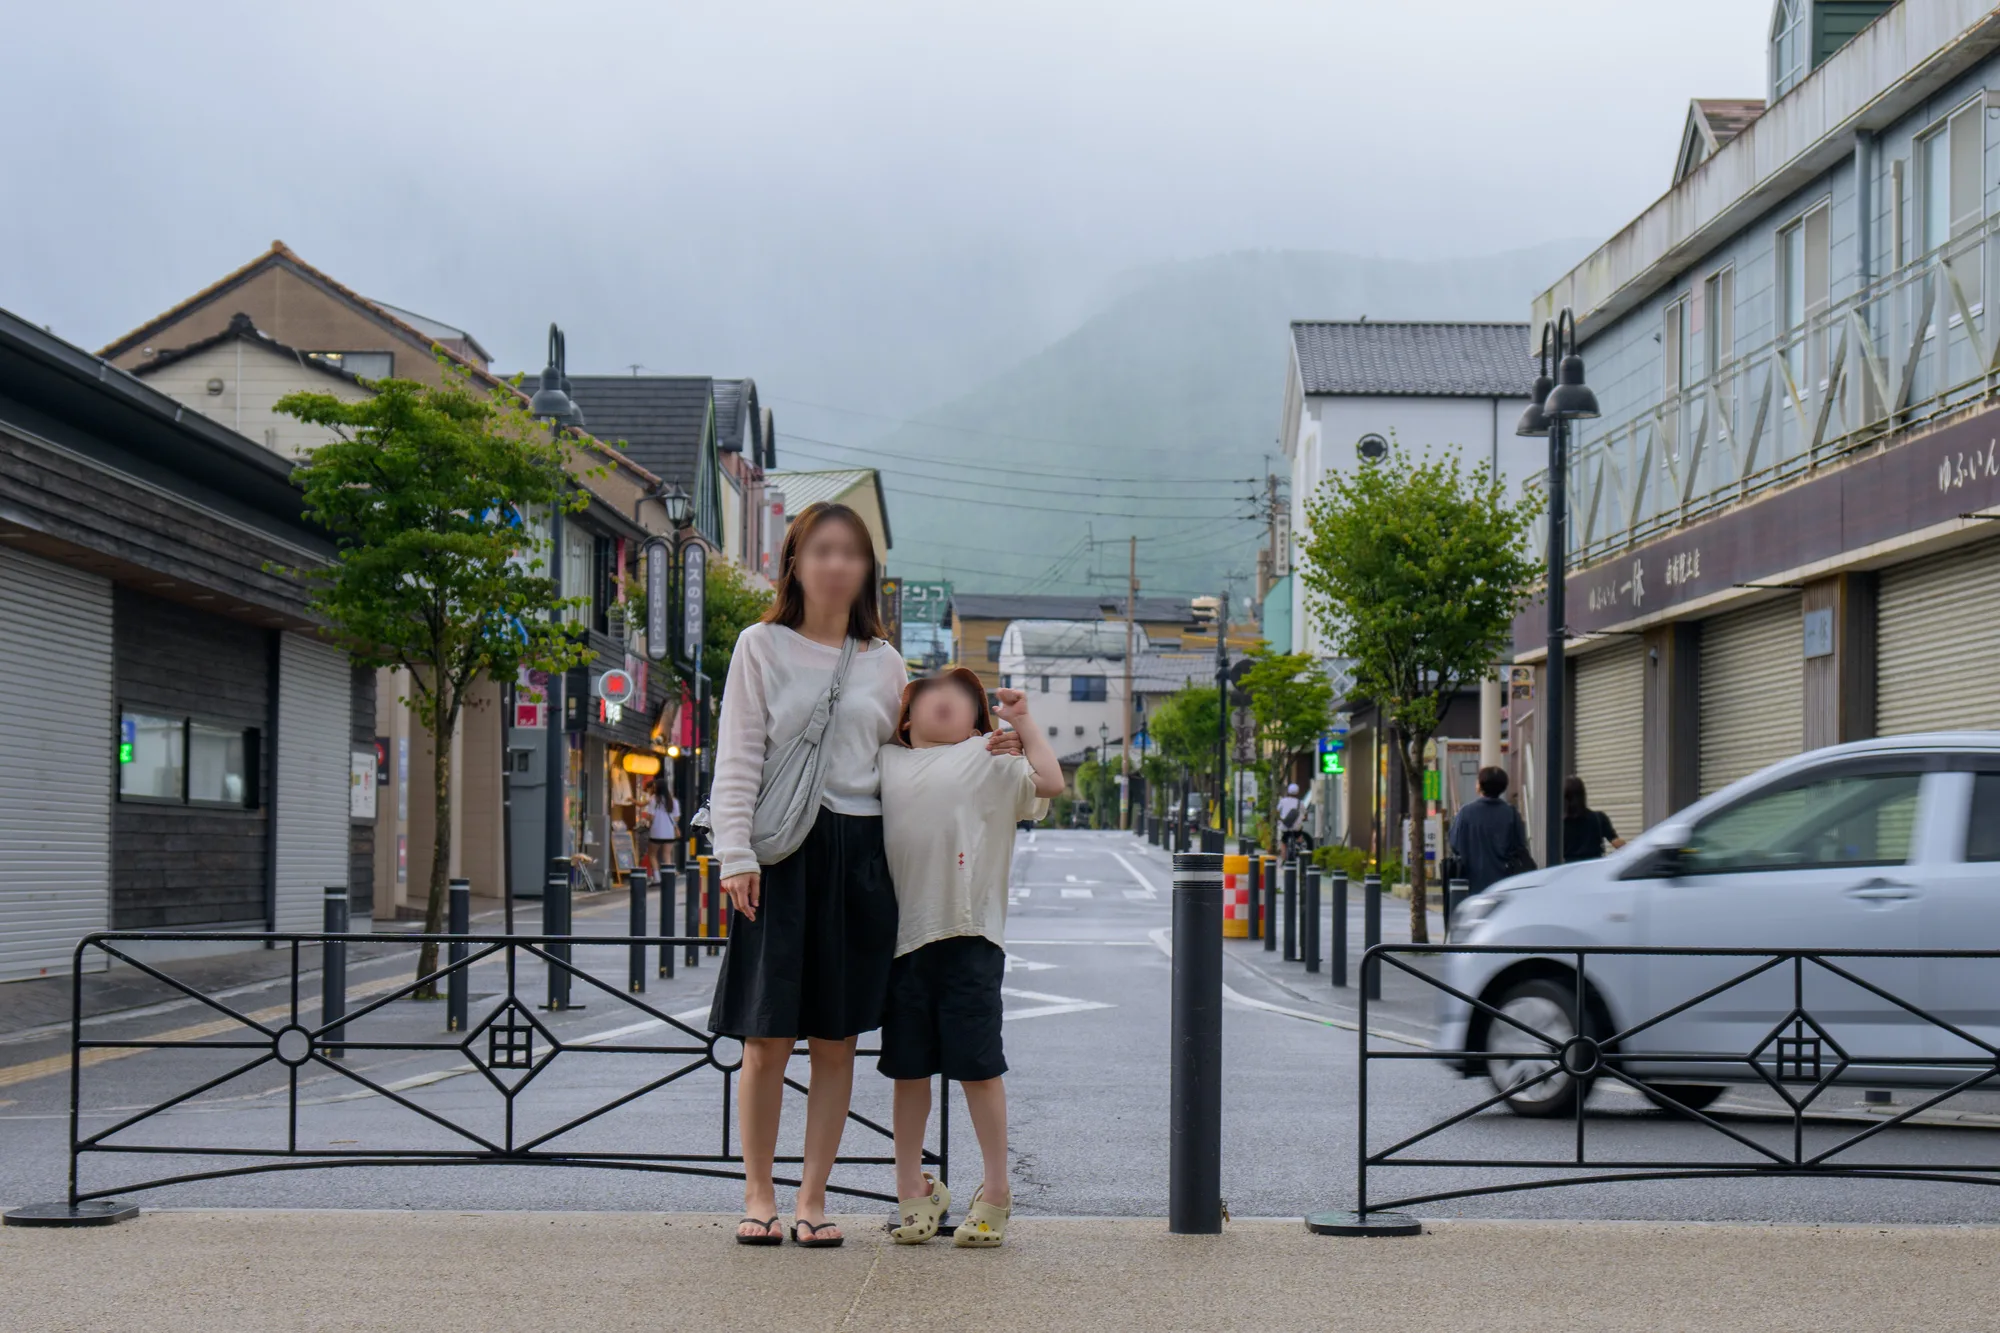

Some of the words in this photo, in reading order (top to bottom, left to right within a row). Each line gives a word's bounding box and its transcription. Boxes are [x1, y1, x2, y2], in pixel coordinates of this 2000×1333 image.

[687, 551, 701, 635] バスのりば
